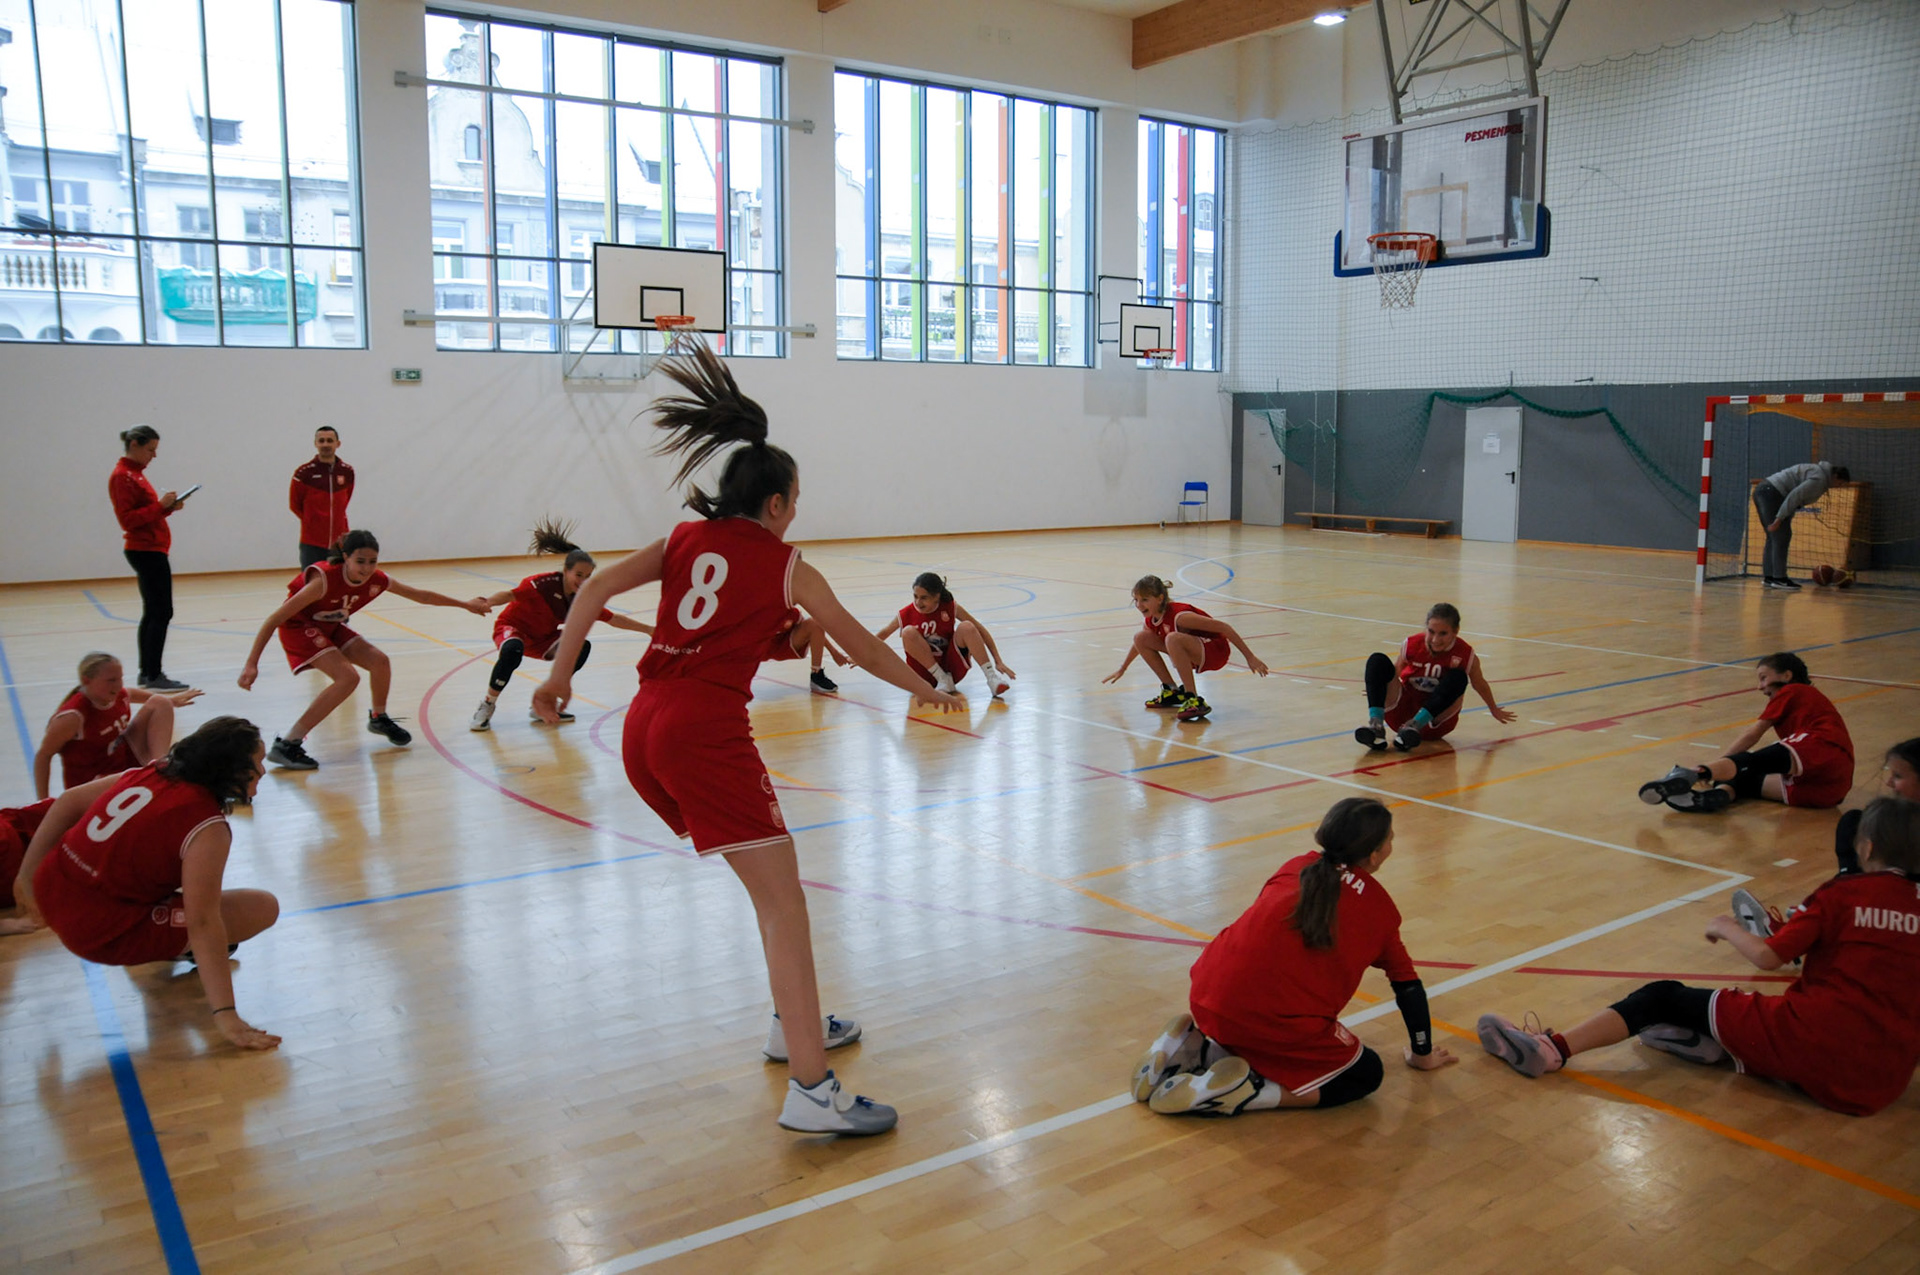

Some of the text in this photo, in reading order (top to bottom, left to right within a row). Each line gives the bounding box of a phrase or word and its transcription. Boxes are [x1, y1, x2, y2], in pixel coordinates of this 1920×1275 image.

[676, 551, 729, 631] 8
[921, 620, 937, 638] 22
[1424, 662, 1441, 679] 10
[86, 786, 154, 843] 9
[1854, 906, 1920, 935] MURO
